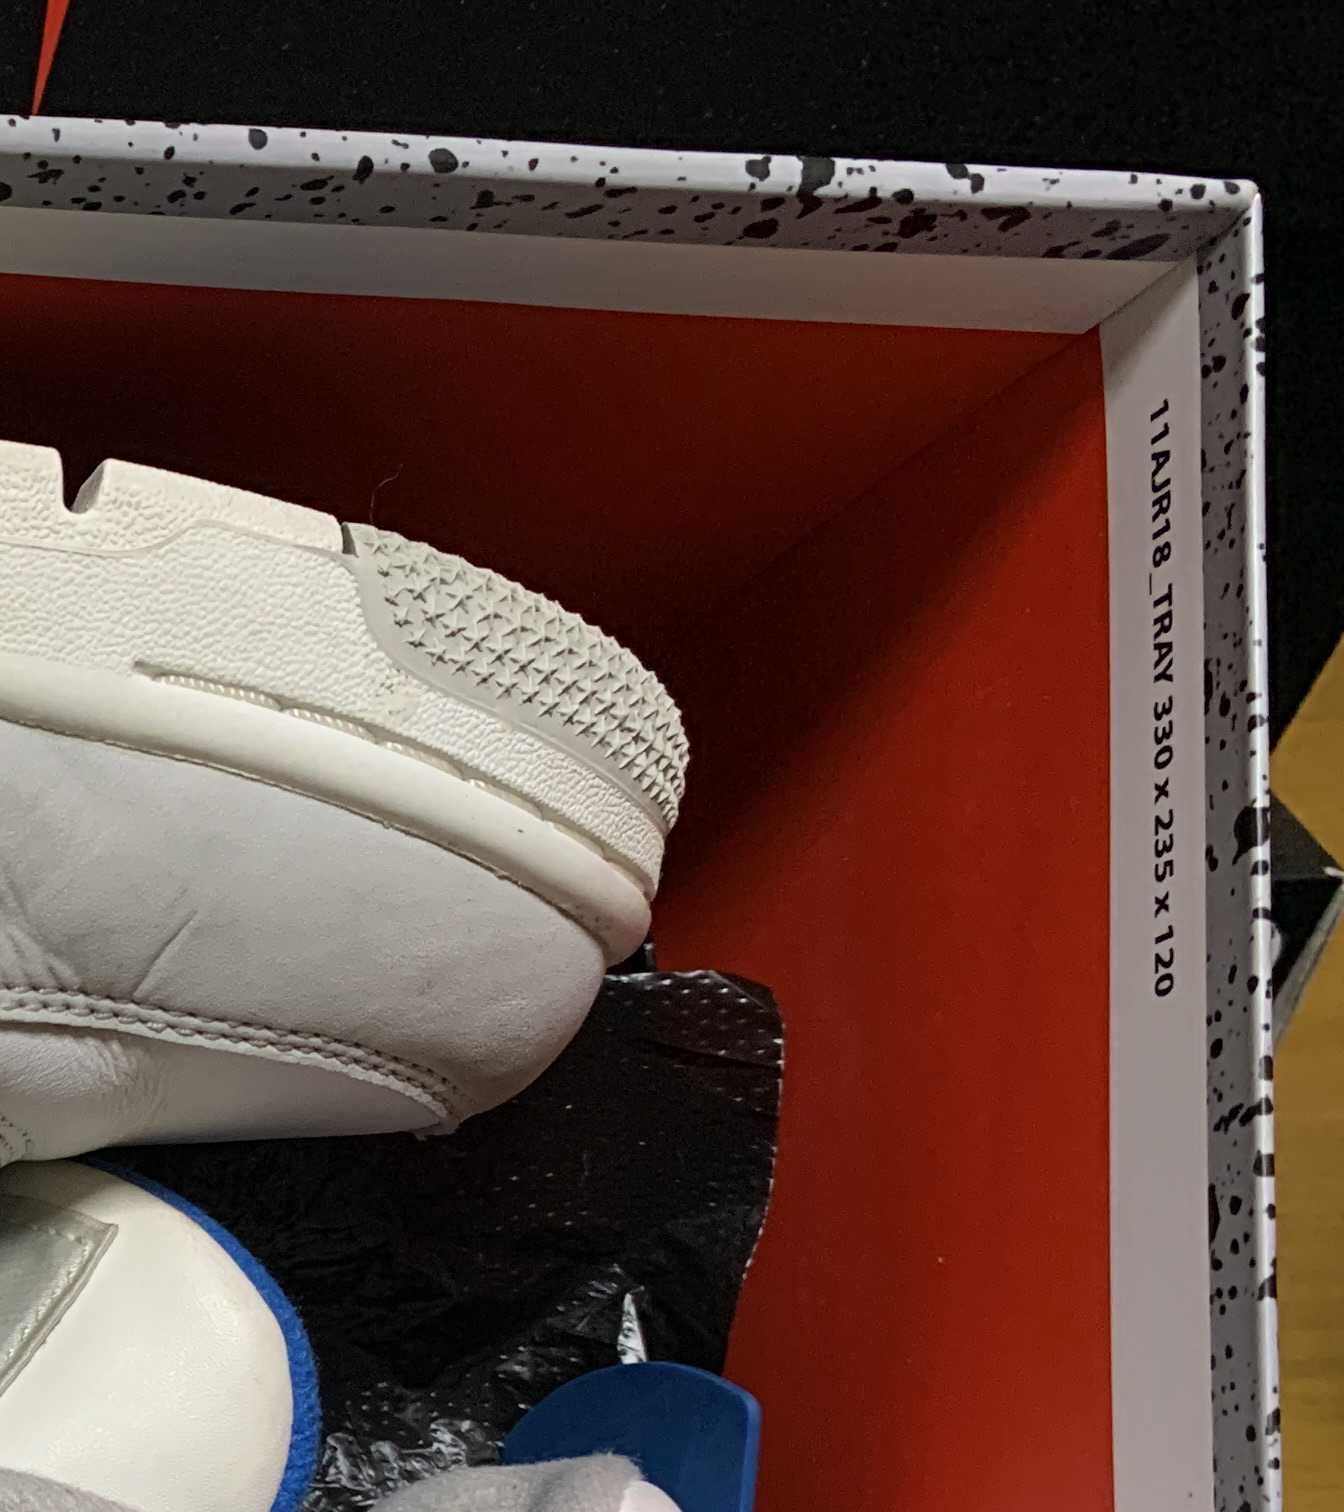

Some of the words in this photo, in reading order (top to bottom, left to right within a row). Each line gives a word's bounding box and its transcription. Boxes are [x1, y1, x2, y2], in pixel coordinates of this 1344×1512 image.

[1149, 398, 1174, 685] 11AJR18_TRAY
[1153, 695, 1174, 770] 330
[1154, 777, 1170, 805] x
[1154, 808, 1175, 883] 235
[1154, 890, 1170, 918] x
[1154, 924, 1175, 998] 120
